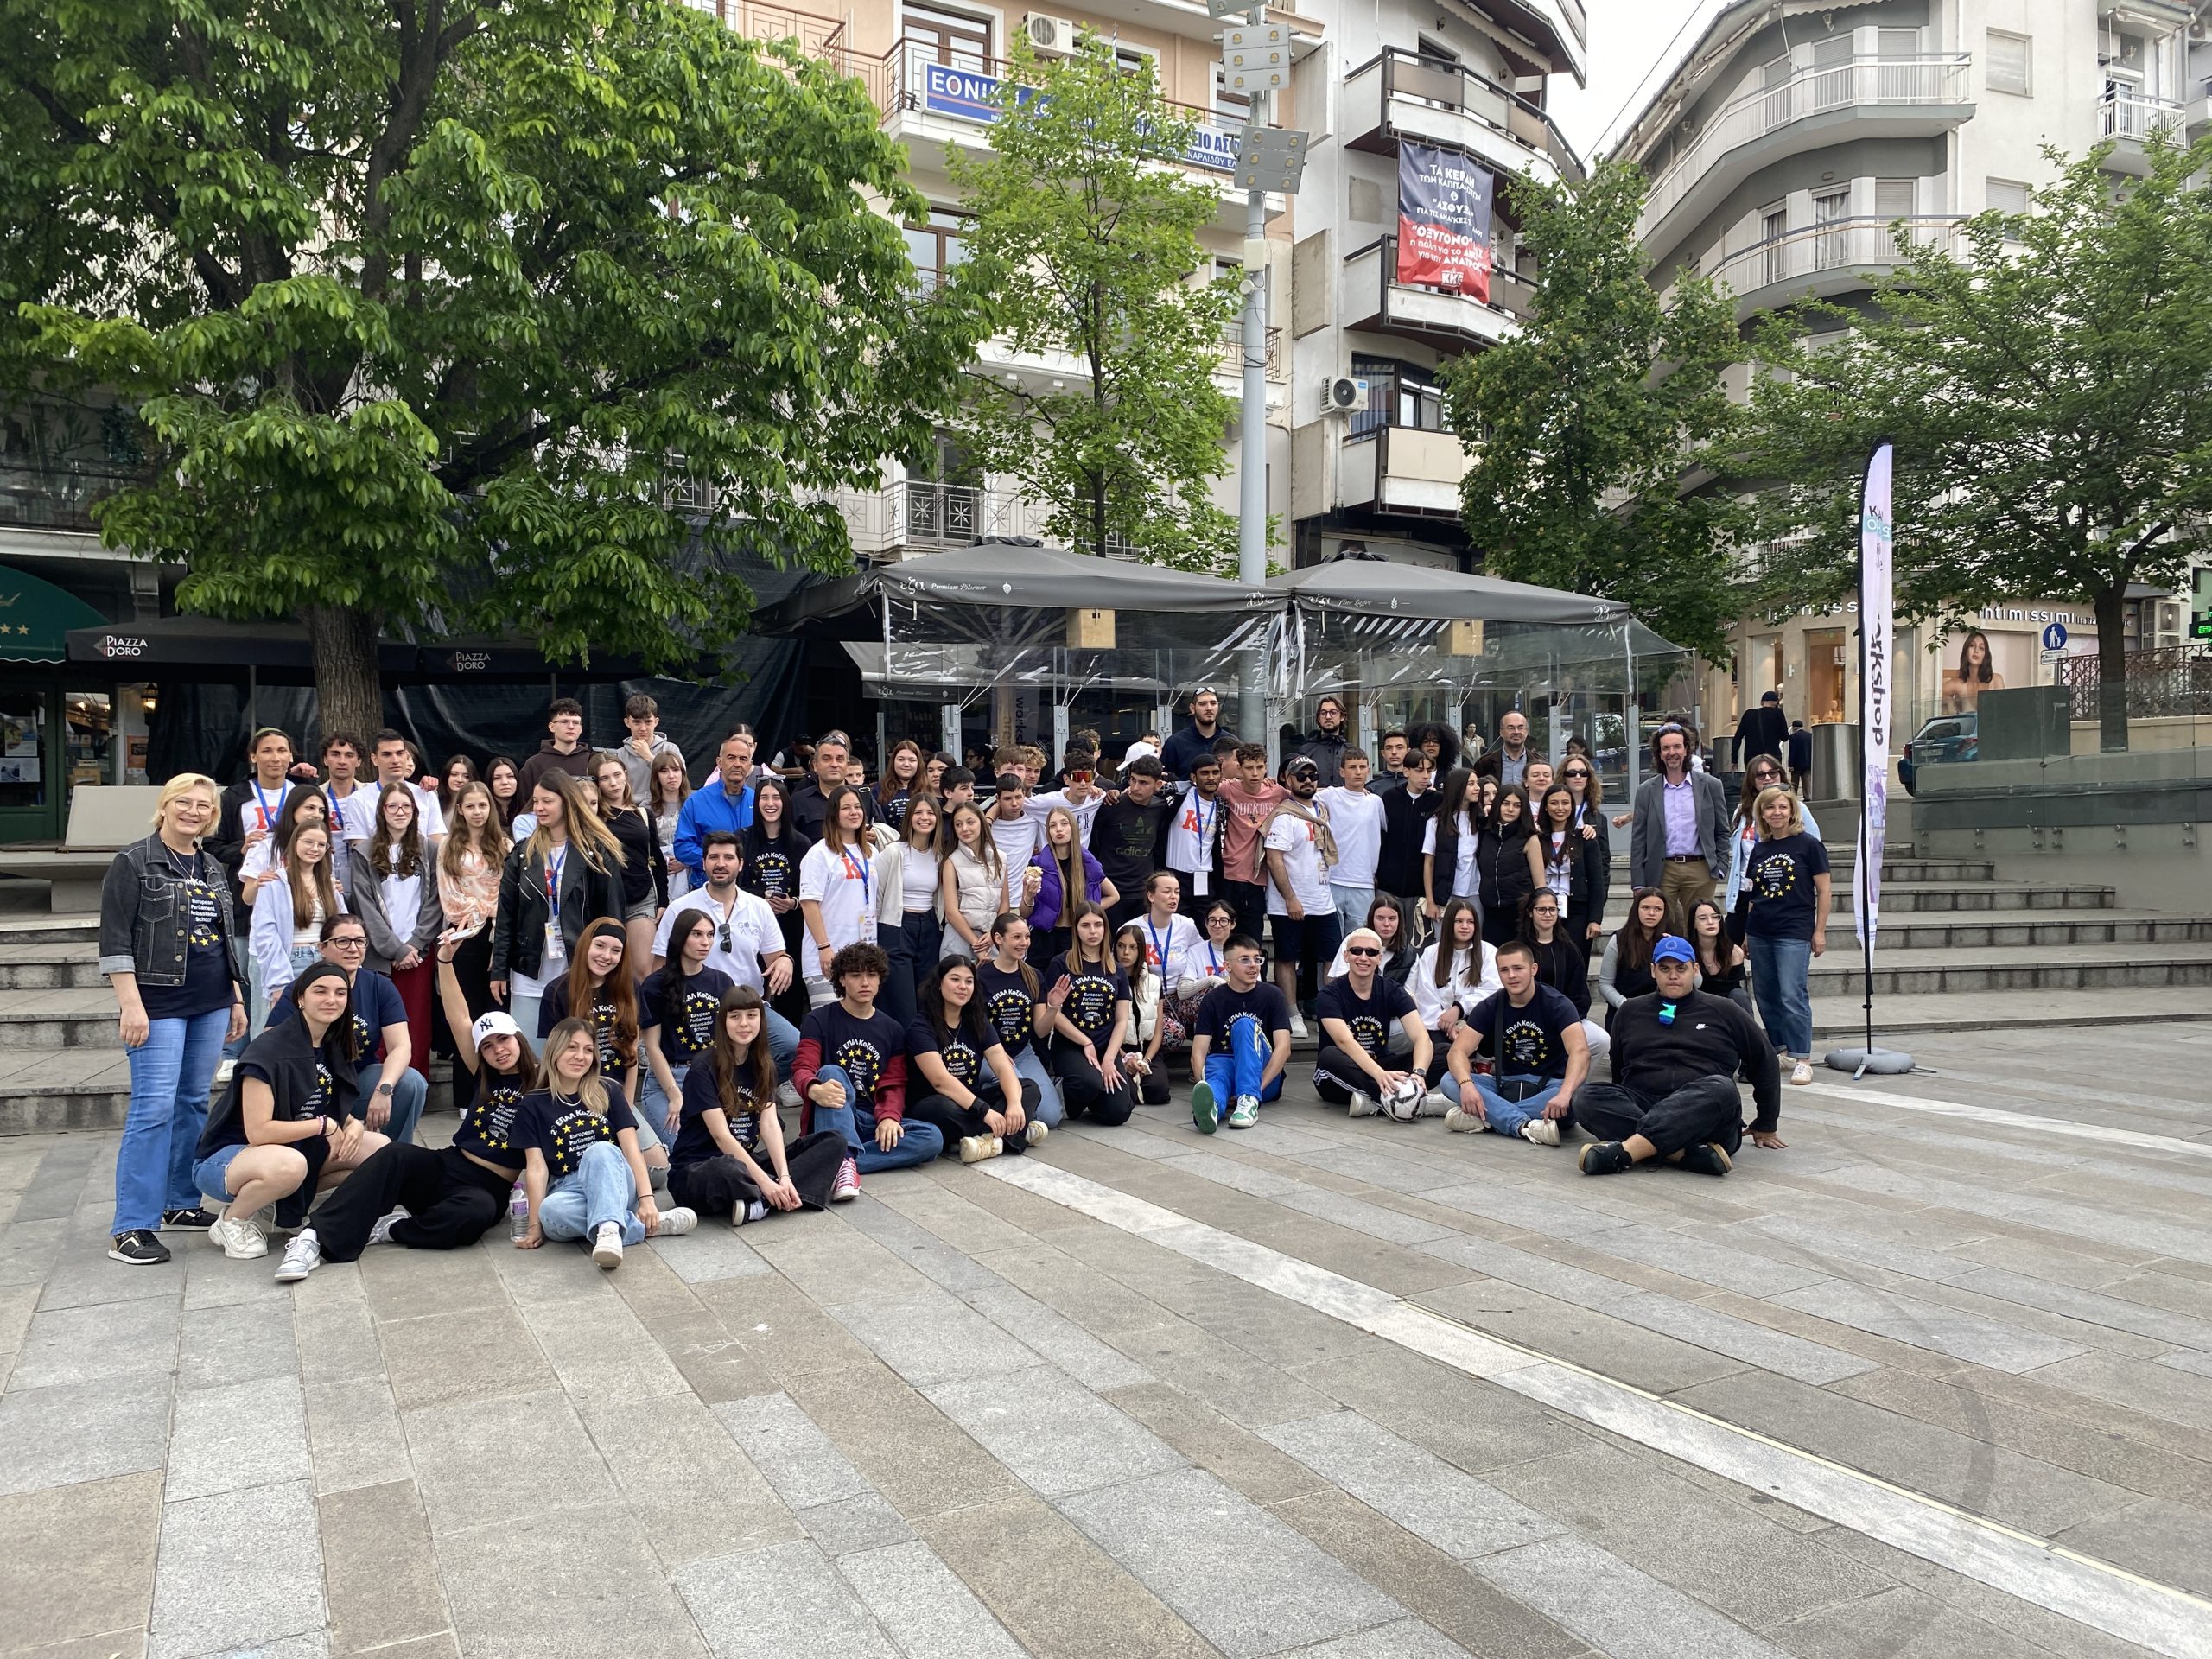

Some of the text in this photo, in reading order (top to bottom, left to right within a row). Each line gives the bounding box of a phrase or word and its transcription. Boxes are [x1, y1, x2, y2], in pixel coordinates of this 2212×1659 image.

[107, 635, 148, 647] PIAZZA
[107, 646, 141, 657] DORO
[455, 652, 491, 662] PIAZZA
[457, 661, 485, 671] DORO
[858, 1039, 881, 1061] Κοζάνης
[554, 1112, 576, 1127] ΕΠΑΛ
[575, 1109, 608, 1124] Κοζάνης
[569, 1129, 594, 1140] European
[569, 1135, 596, 1146] Parliament
